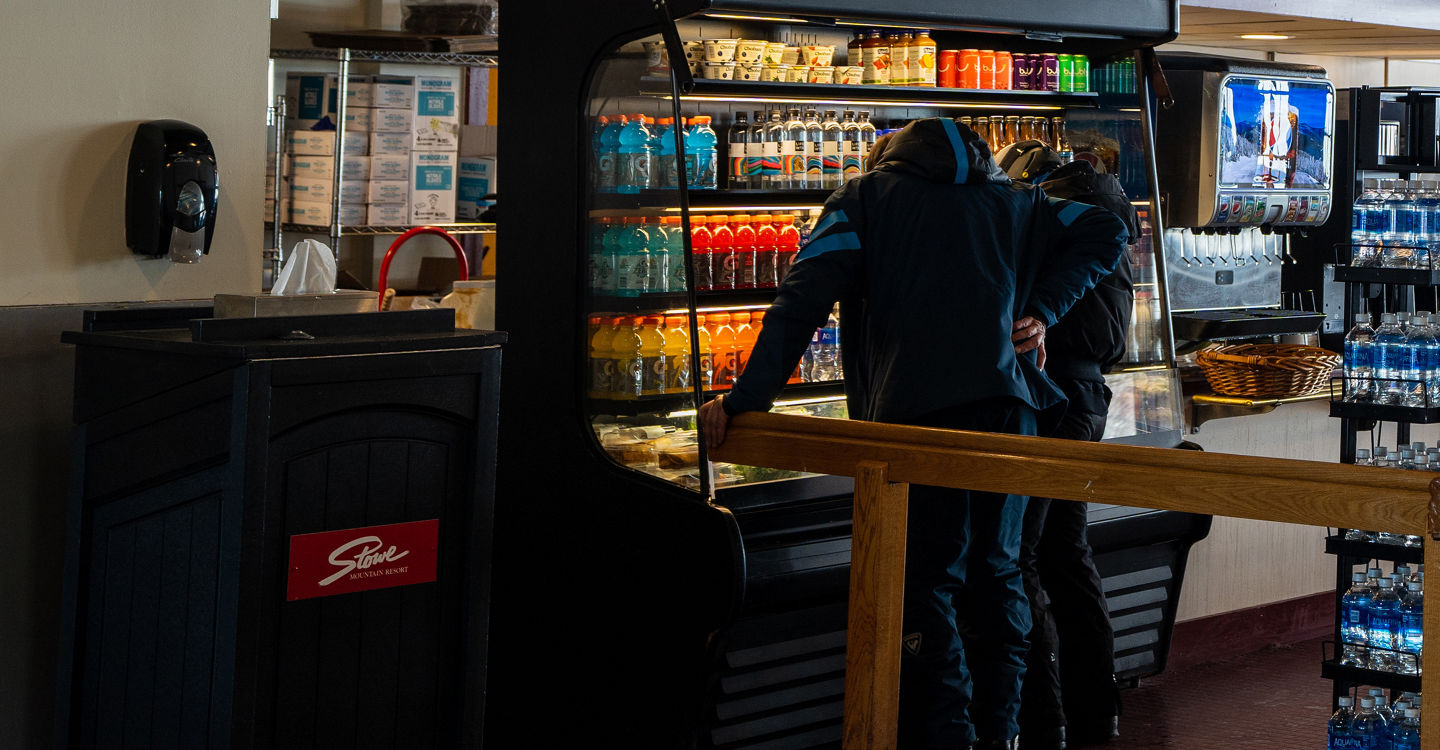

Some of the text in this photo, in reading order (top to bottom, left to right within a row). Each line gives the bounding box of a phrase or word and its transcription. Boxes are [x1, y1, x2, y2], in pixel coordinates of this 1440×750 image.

[318, 536, 410, 586] Stowe
[350, 566, 409, 580] MOUNTAIN RESORT
